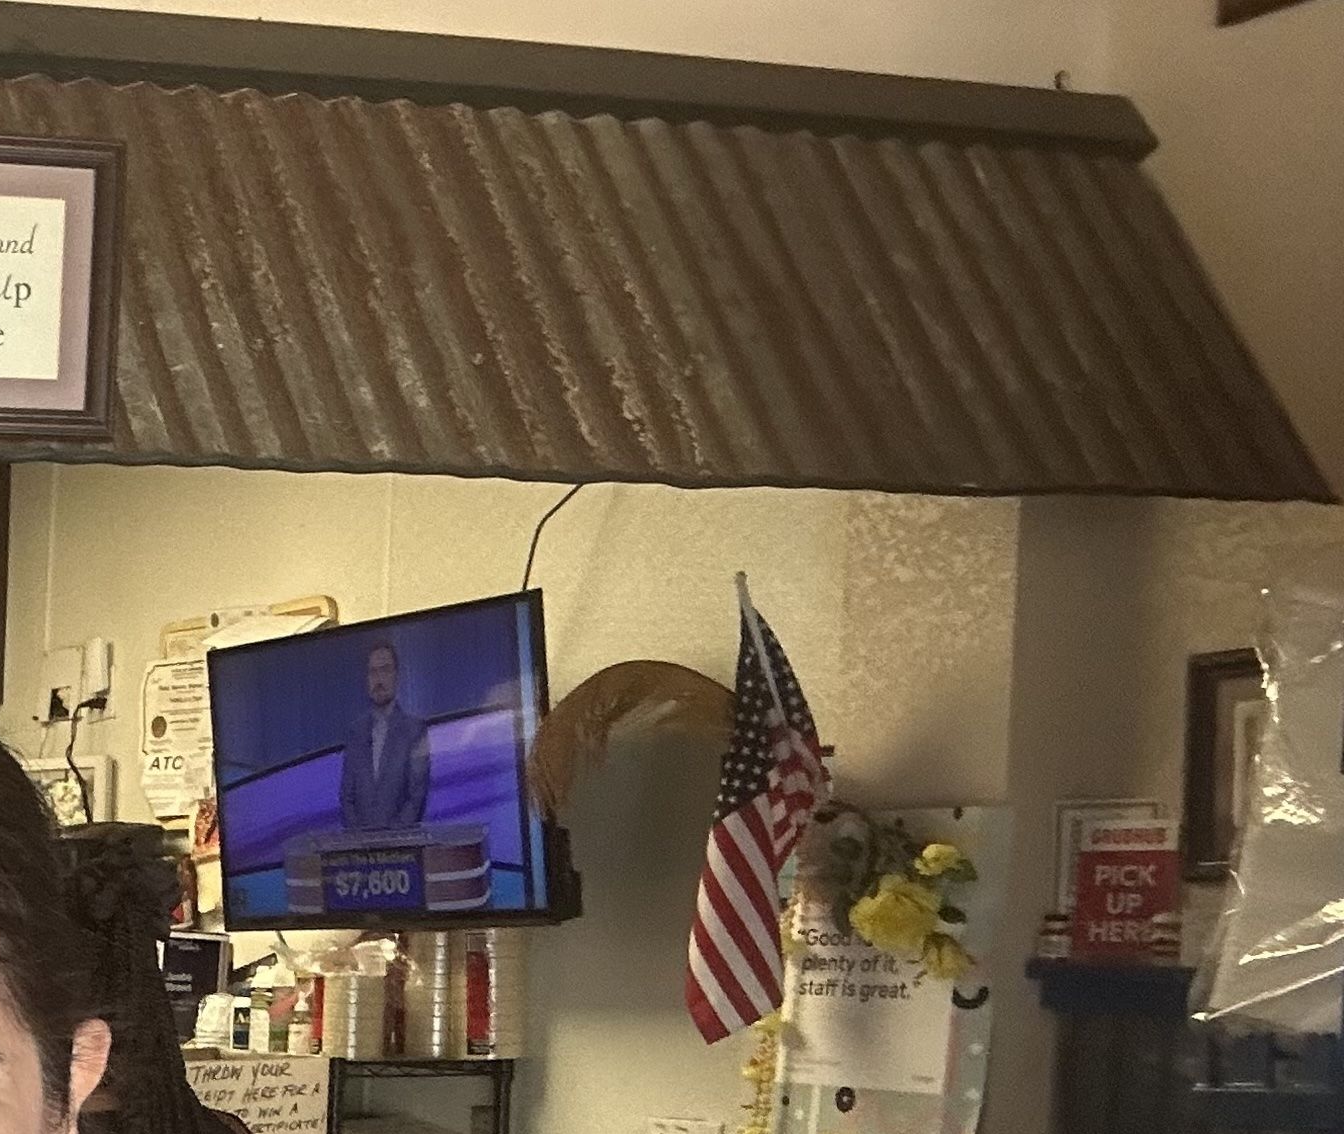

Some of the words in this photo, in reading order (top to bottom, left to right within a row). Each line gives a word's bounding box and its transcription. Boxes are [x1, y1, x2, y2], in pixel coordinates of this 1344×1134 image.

[149, 755, 185, 771] ATC
[334, 868, 411, 899] $7,600
[1094, 864, 1157, 886] PICK
[1106, 892, 1143, 915] UP
[802, 953, 855, 975] plenty
[860, 954, 879, 972] of
[798, 979, 839, 996] staff
[842, 977, 856, 998] is
[190, 1065, 243, 1084] THROW
[252, 1063, 292, 1088] YOUR
[242, 1086, 279, 1103] HERE
[280, 1083, 307, 1098] FOR
[258, 1106, 283, 1118] WIN
[289, 1102, 298, 1116] A
